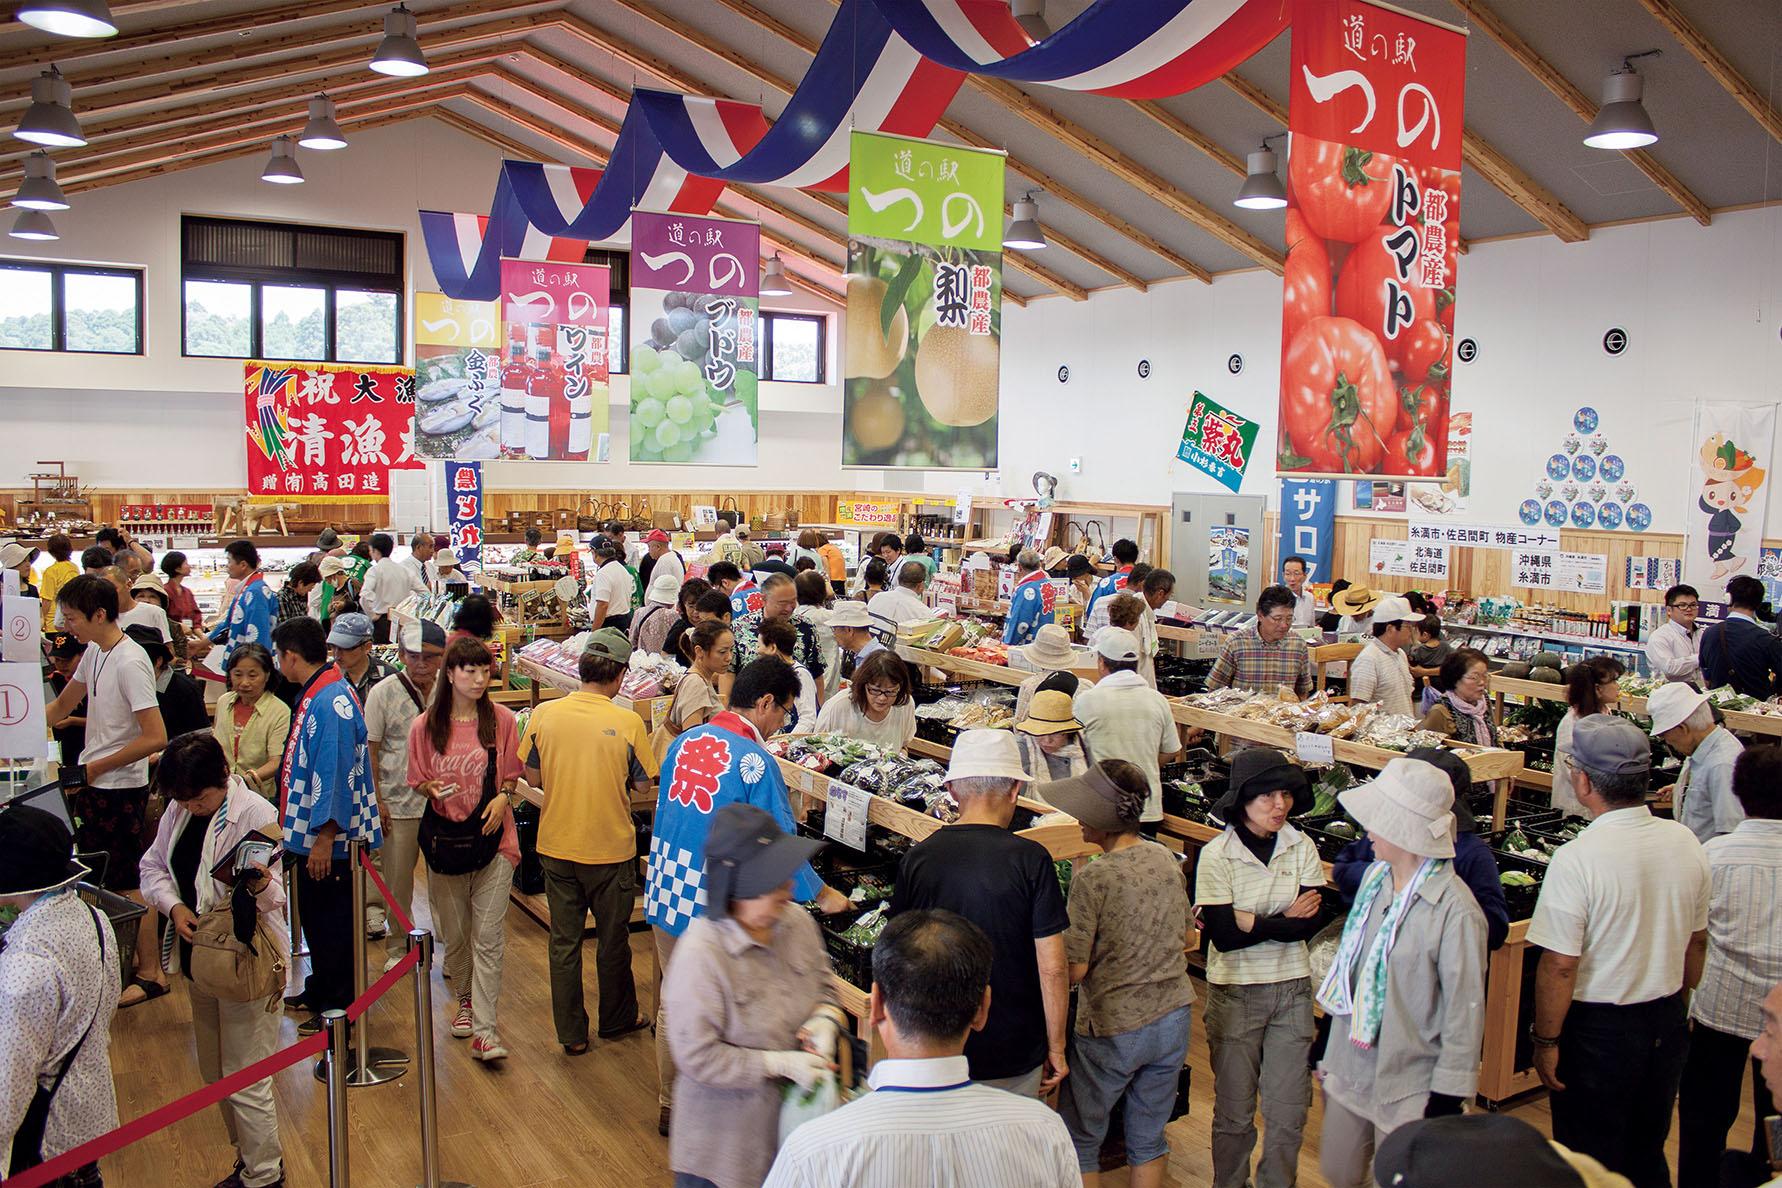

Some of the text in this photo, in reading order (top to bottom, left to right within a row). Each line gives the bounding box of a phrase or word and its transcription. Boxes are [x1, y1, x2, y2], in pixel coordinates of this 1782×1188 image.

[1343, 14, 1416, 73] 道の駅
[1302, 64, 1440, 150] つの
[893, 149, 960, 186] 道の駅
[667, 223, 724, 248] 道の駅
[861, 186, 984, 239] つの
[1420, 188, 1448, 290] 都農産
[532, 268, 580, 288] 道の駅
[640, 252, 745, 289] つの
[1382, 163, 1421, 340] トマト
[508, 290, 597, 321] つの
[933, 263, 970, 327] 梨
[970, 265, 992, 336] 都農産
[422, 318, 495, 342] つの
[705, 298, 736, 391] ブドウ
[465, 348, 488, 414] 金ふぐ
[563, 327, 588, 400] ワイン
[1202, 411, 1245, 470] 紫丸
[1415, 546, 1444, 560] 北海道
[1495, 531, 1558, 547] 物産コーナー
[1519, 553, 1552, 569] 沖縄県
[1409, 561, 1447, 576] 佐呂間町
[1518, 570, 1552, 586] 糸満市
[668, 732, 732, 815] 祭
